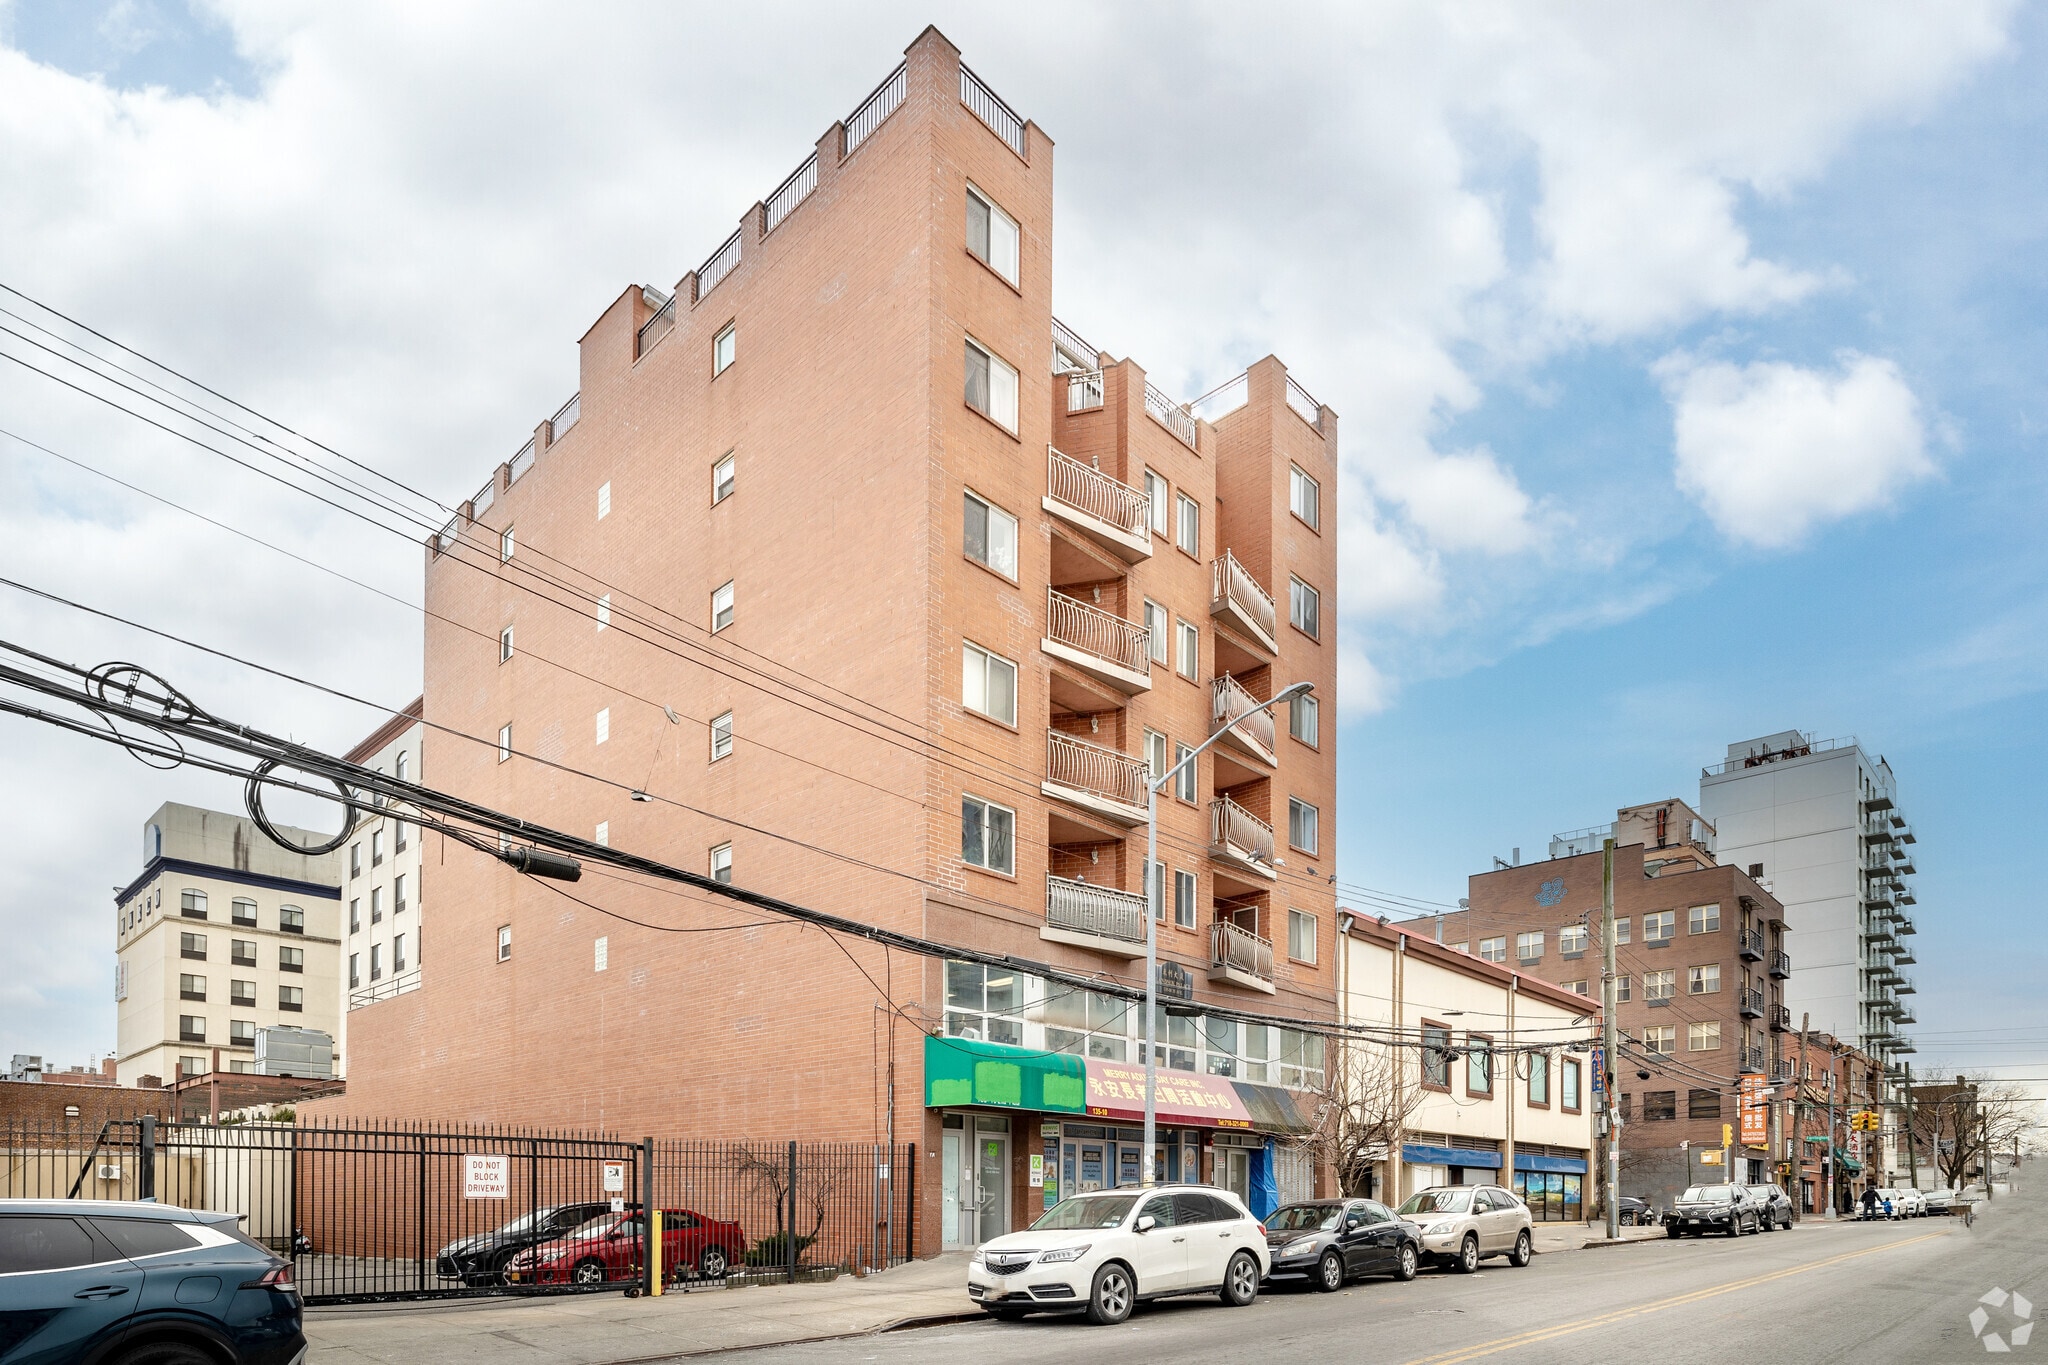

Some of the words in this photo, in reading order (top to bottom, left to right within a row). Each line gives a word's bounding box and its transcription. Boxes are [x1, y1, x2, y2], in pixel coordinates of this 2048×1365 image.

[1103, 1068, 1130, 1080] MERRY
[1131, 1073, 1148, 1082] ADU
[1156, 1075, 1169, 1085] DAY
[1169, 1077, 1190, 1087] CARE
[1190, 1079, 1205, 1089] INC.
[1092, 1108, 1108, 1116] 135-10
[473, 1161, 483, 1169] DO
[486, 1161, 500, 1169] NOT
[474, 1172, 498, 1181] BLOCK
[467, 1184, 505, 1192] DRIVEWAY
